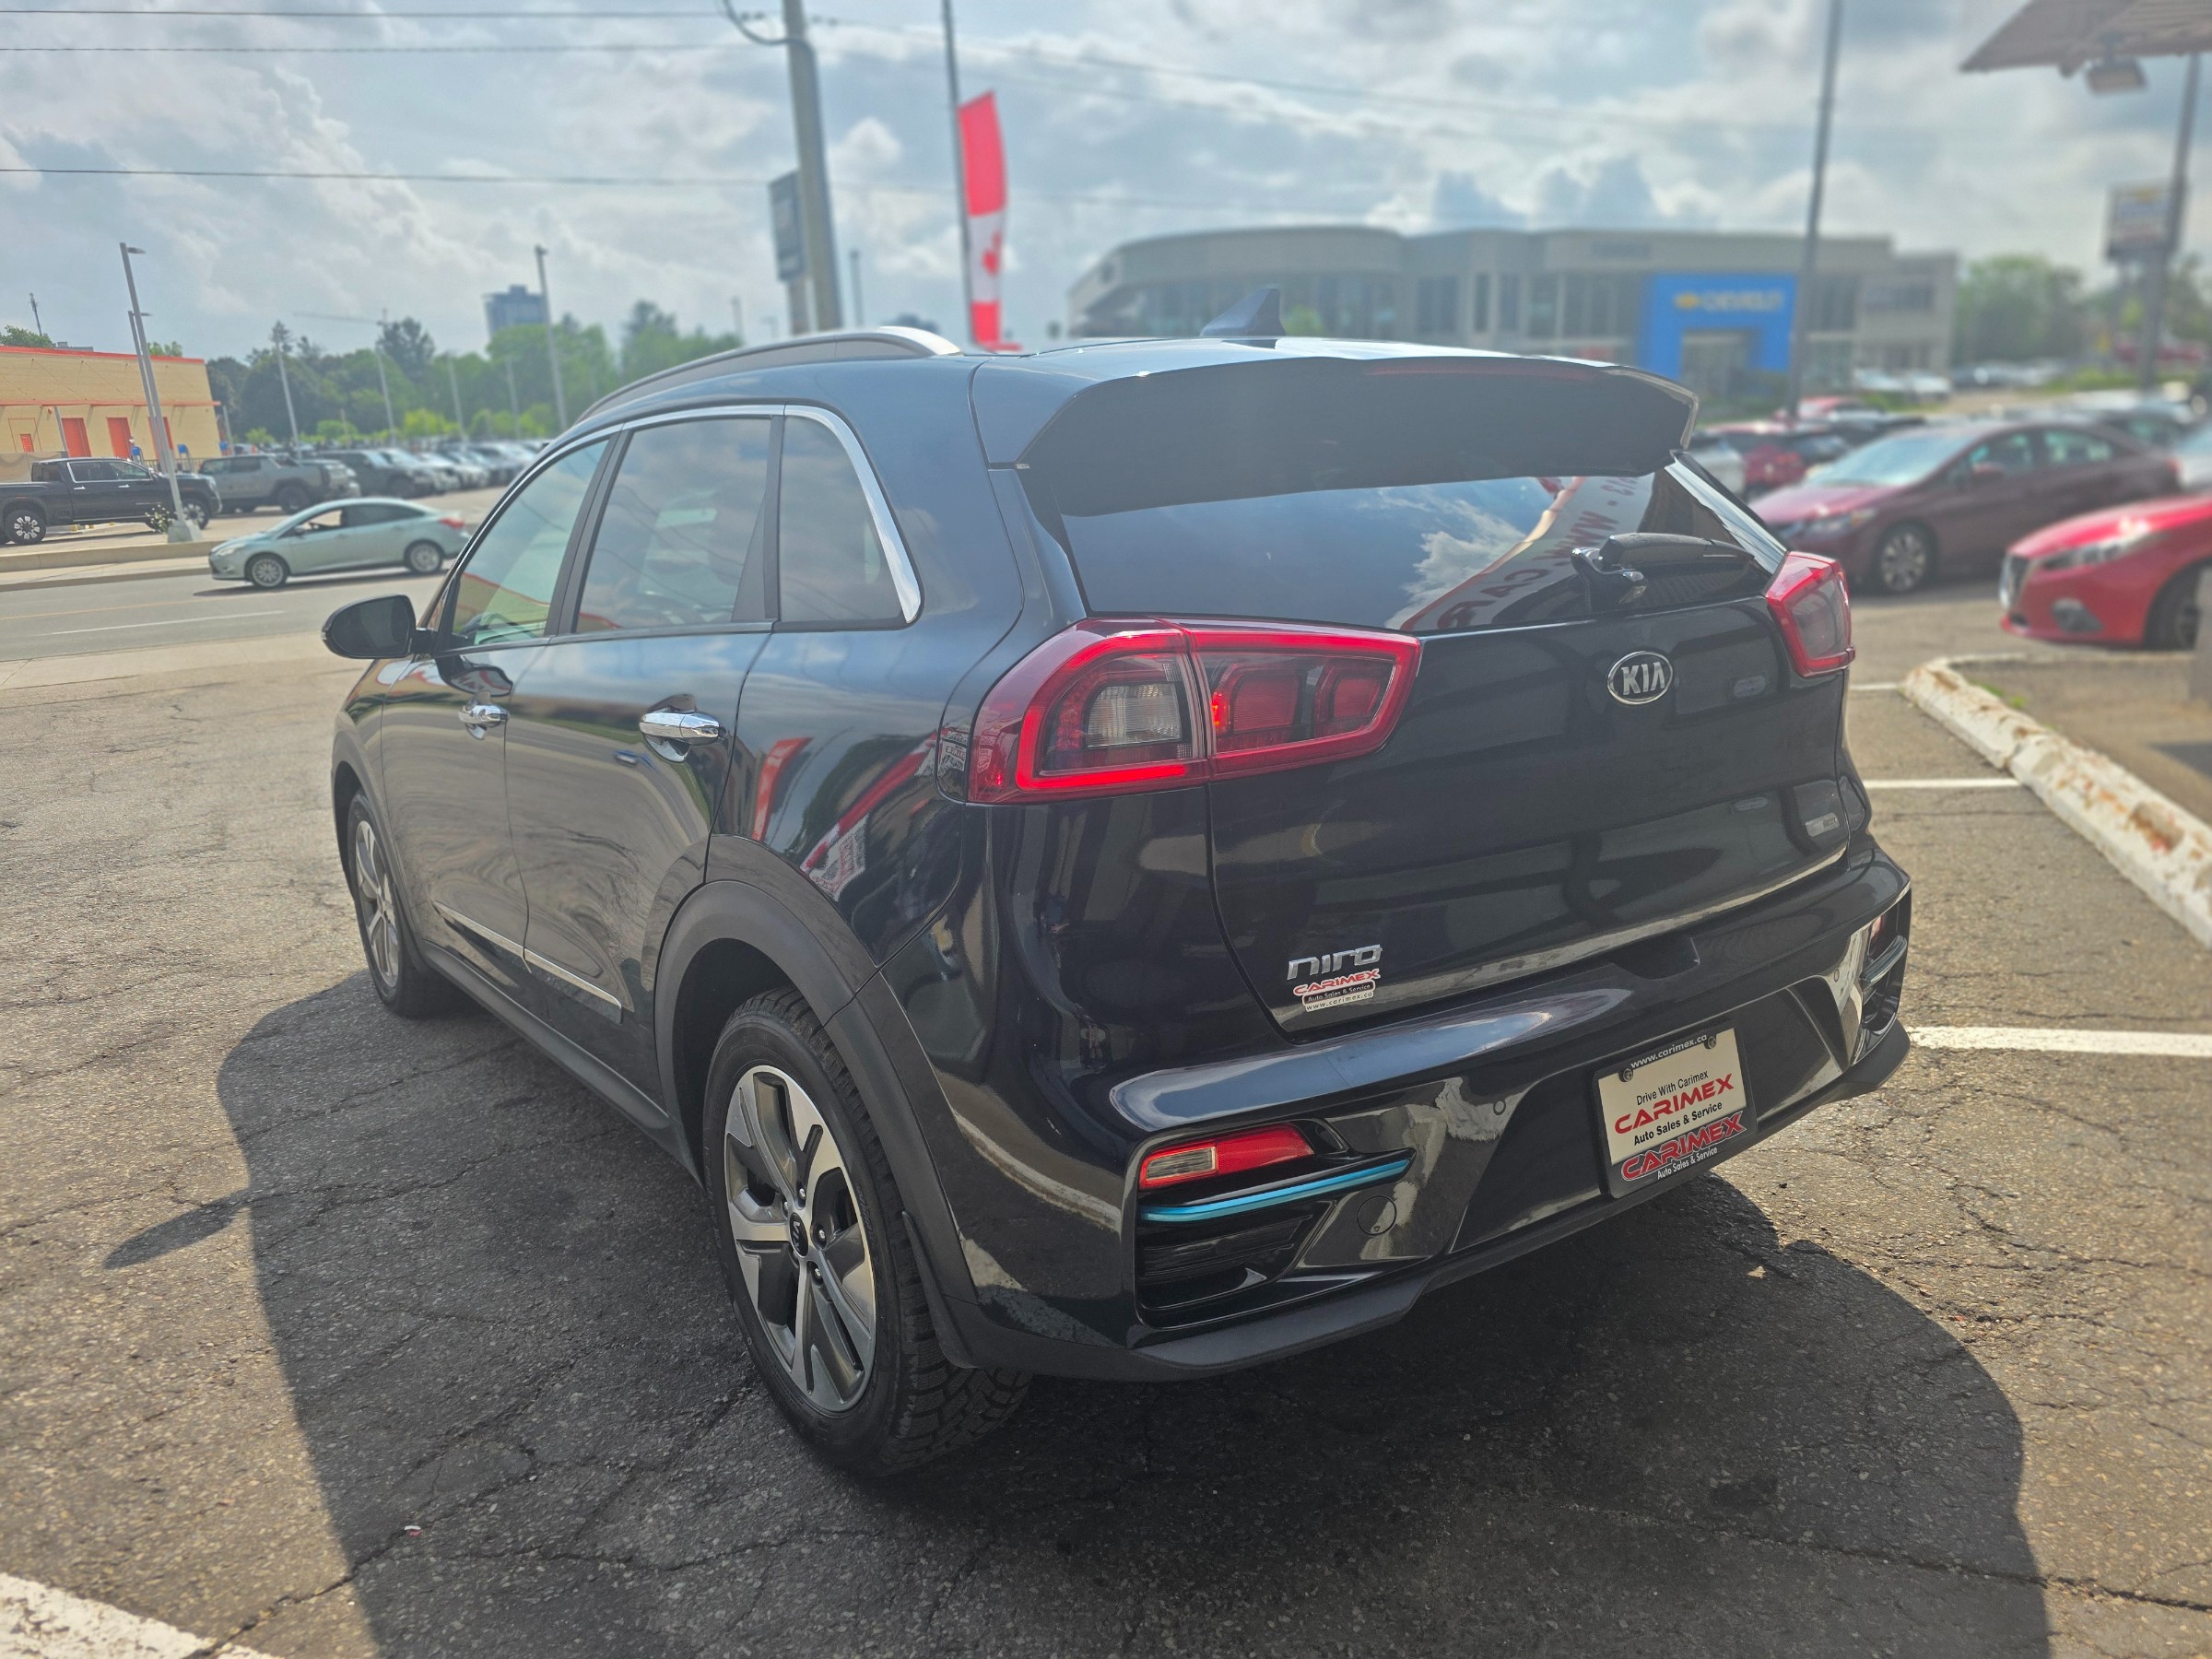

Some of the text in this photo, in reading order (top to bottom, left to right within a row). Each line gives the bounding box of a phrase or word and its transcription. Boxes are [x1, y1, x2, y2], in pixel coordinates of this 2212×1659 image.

[1621, 662, 1665, 696] KIA
[1293, 969, 1381, 995] CARIMEX
[1308, 994, 1324, 1003] Auto
[1324, 991, 1341, 999] Sales
[1348, 983, 1371, 994] Service
[1306, 992, 1373, 1011] www.carimex.ca
[1630, 1034, 1708, 1068] www.carimex.ca
[1615, 1073, 1735, 1135] CARIMEX
[1636, 1070, 1709, 1106] Drive With Carimex
[1634, 1100, 1723, 1146] Auto Sales & Service
[1621, 1111, 1747, 1181] CARIMEX
[1657, 1166, 1672, 1181] Auto
[1672, 1160, 1689, 1173] Sales
[1696, 1146, 1718, 1161] Service
